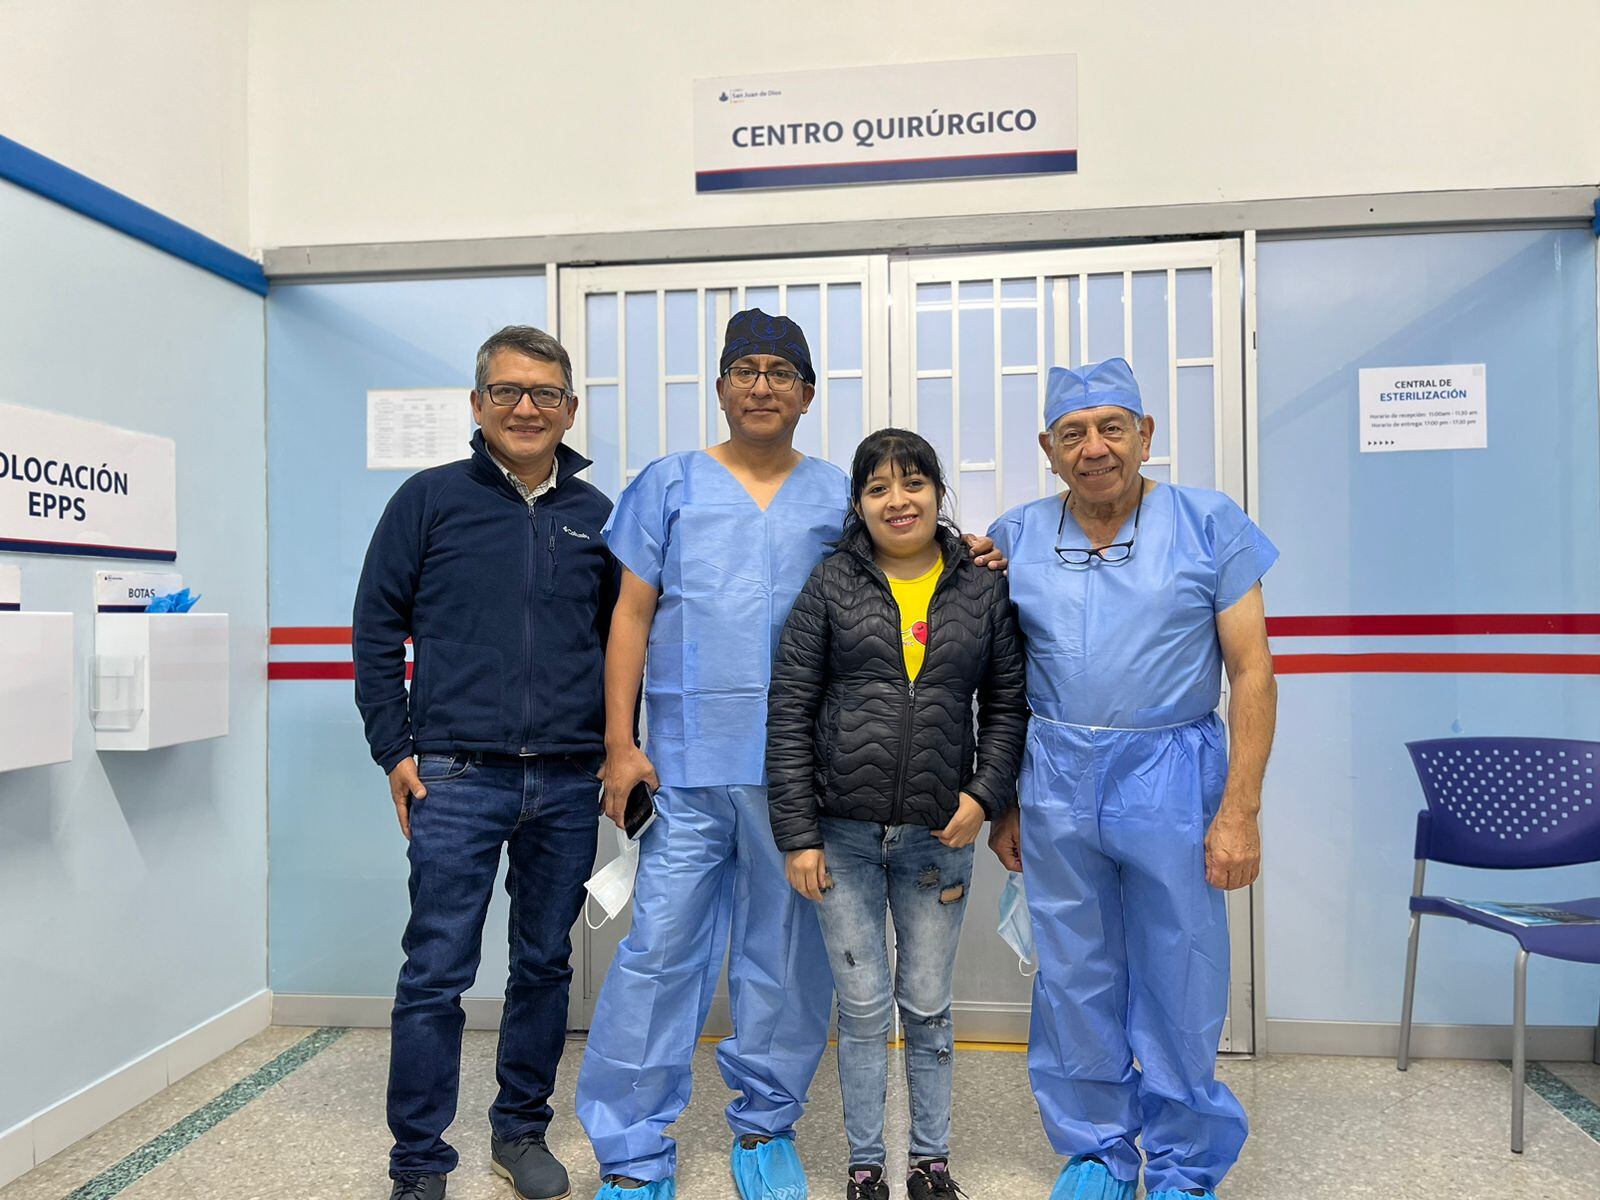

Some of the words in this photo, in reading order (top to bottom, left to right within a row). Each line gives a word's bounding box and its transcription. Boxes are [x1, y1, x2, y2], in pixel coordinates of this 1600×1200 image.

[732, 120, 843, 148] CENTRO
[853, 109, 1037, 147] QUIRÚRGICO
[1394, 379, 1437, 389] CENTRAL
[1439, 379, 1452, 387] DE
[1380, 389, 1467, 402] ESTERILIZACIÓN
[29, 491, 86, 522] EPPS
[128, 588, 155, 599] BOTAS
